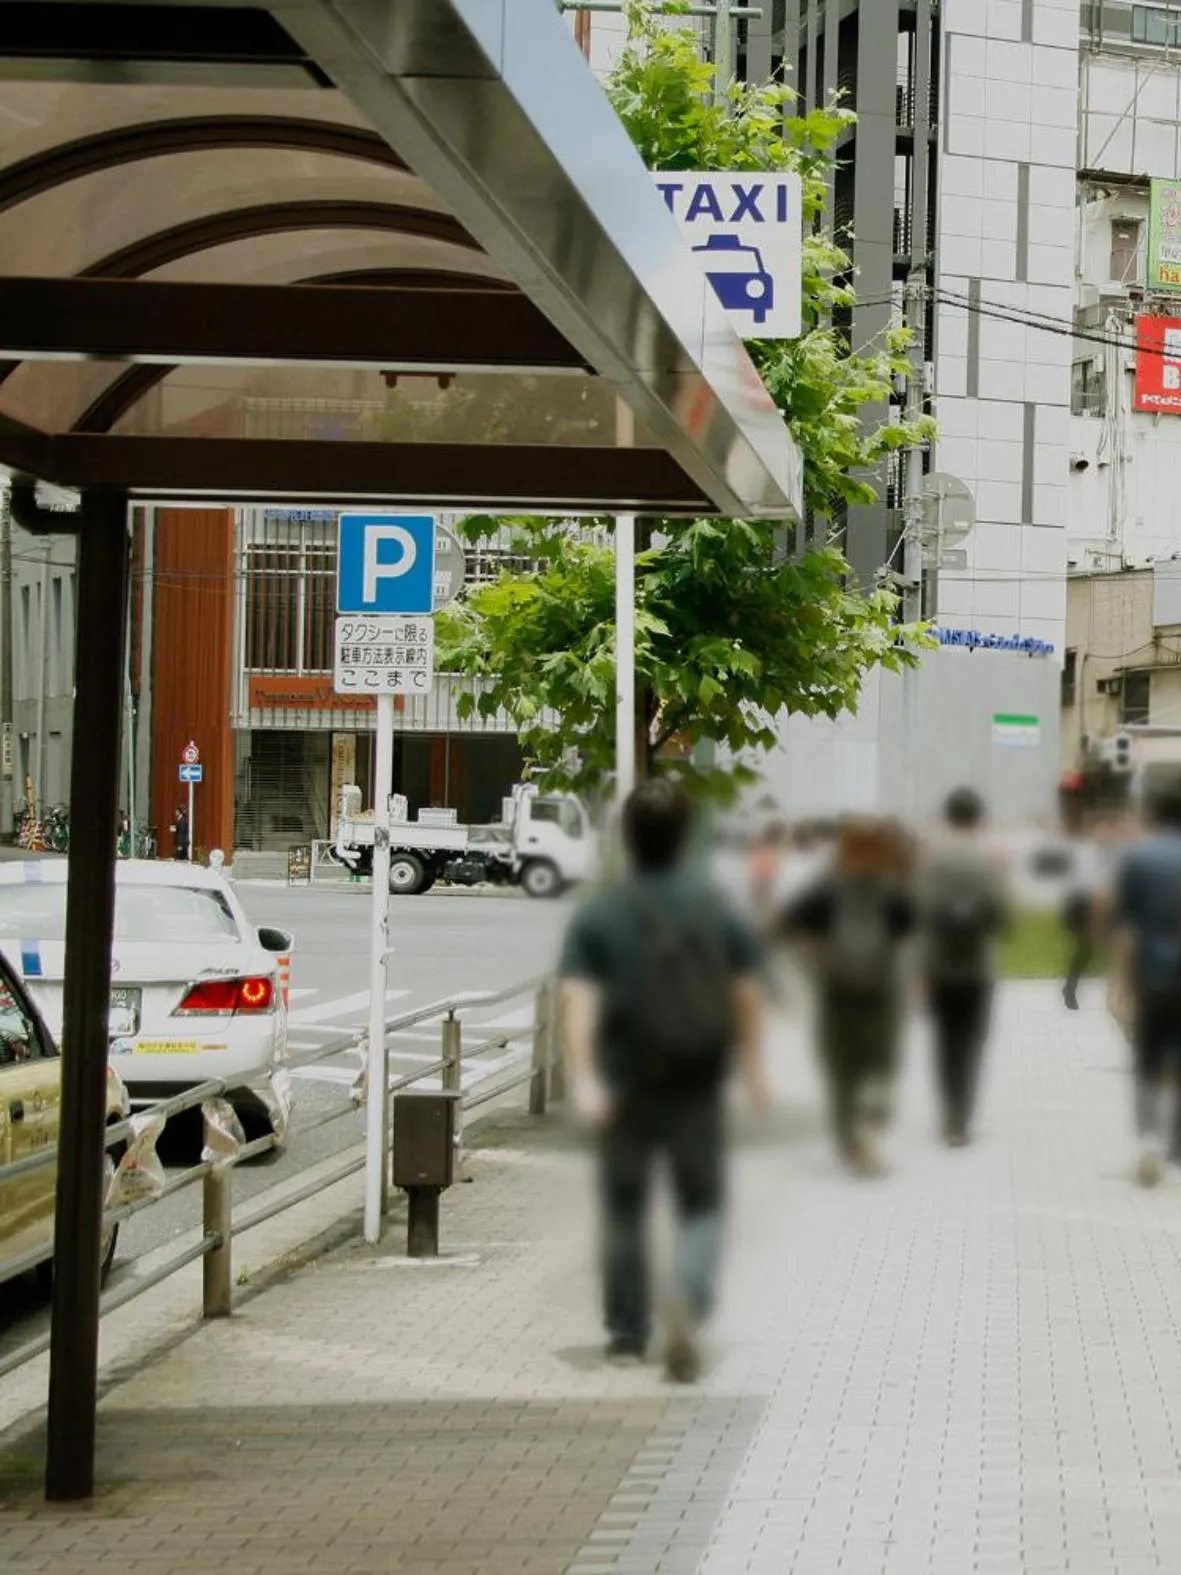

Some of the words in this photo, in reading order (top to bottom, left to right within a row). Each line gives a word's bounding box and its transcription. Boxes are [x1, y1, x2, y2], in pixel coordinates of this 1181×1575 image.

[655, 183, 788, 223] TAXI
[362, 524, 417, 604] P
[341, 623, 428, 643] タクシーに限る
[340, 646, 428, 666] 駐車方法表示線内
[341, 670, 428, 688] ここまで
